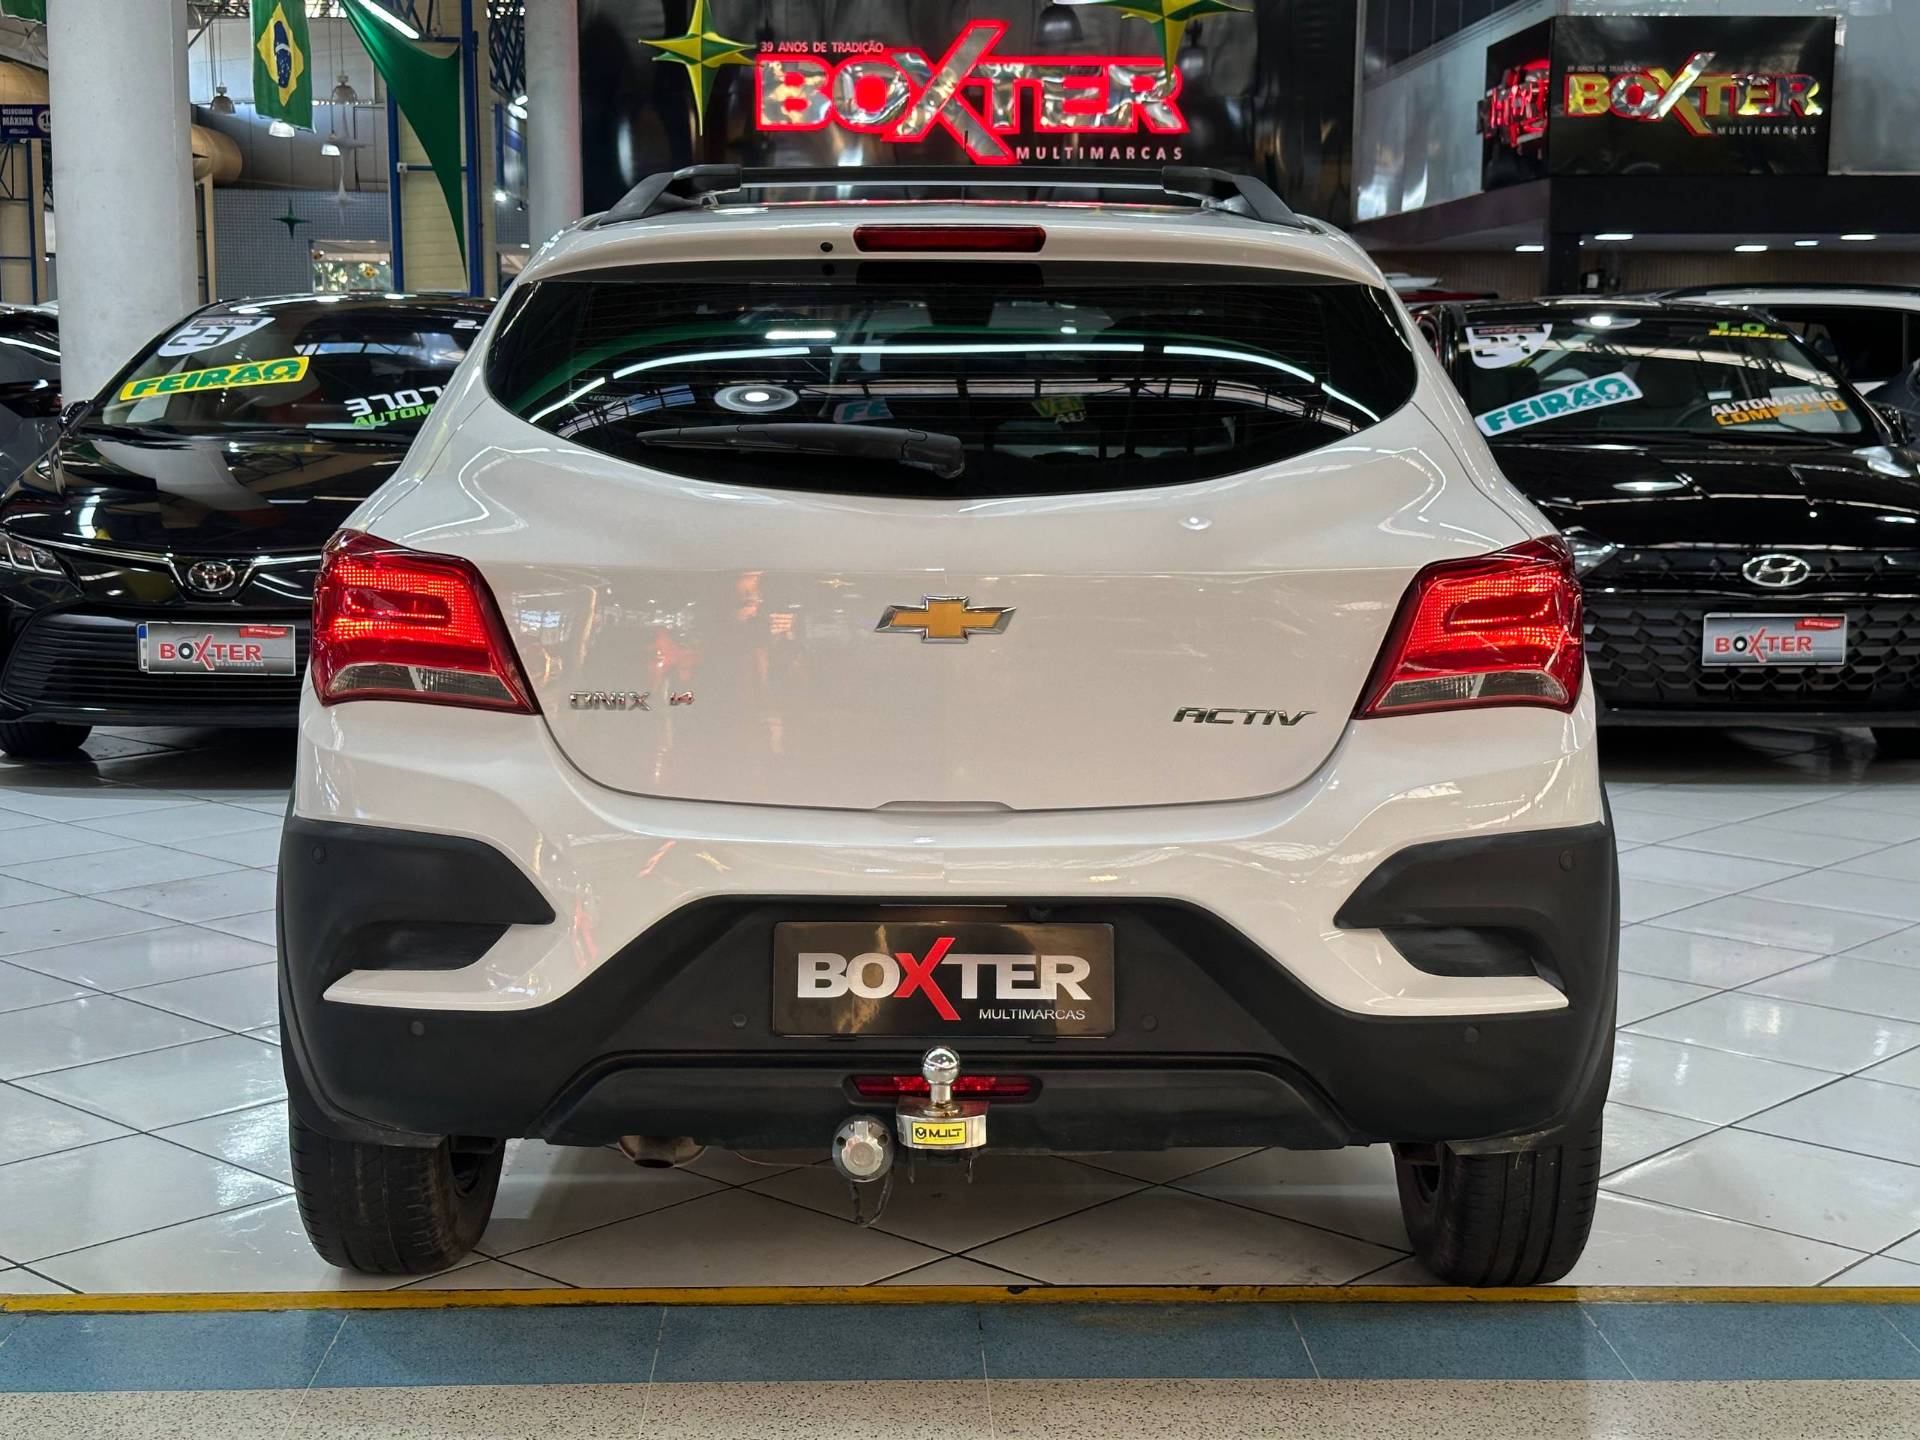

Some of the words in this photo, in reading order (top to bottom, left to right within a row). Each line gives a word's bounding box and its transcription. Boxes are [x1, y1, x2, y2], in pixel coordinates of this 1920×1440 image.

[760, 41, 774, 53] 39
[778, 41, 808, 53] ANOS
[813, 41, 827, 53] DE
[831, 39, 884, 55] TRADIÇÃO
[755, 19, 1190, 164] BOXTER
[1564, 51, 1823, 136] BOXTER
[1717, 127, 1817, 136] MULTIMARCAS
[1016, 146, 1183, 161] MULTIMARCAS
[130, 359, 302, 397] FEIRÃO
[343, 385, 448, 418] 37.07
[1484, 376, 1634, 432] FEIRÃO
[158, 633, 264, 671] BOXTER
[1714, 626, 1813, 663] BOXTER
[569, 690, 651, 712] ONIX
[1172, 706, 1318, 726] ACTIV
[797, 937, 1092, 1021] BOXTER
[978, 1008, 1086, 1020] MULTIMARCAS
